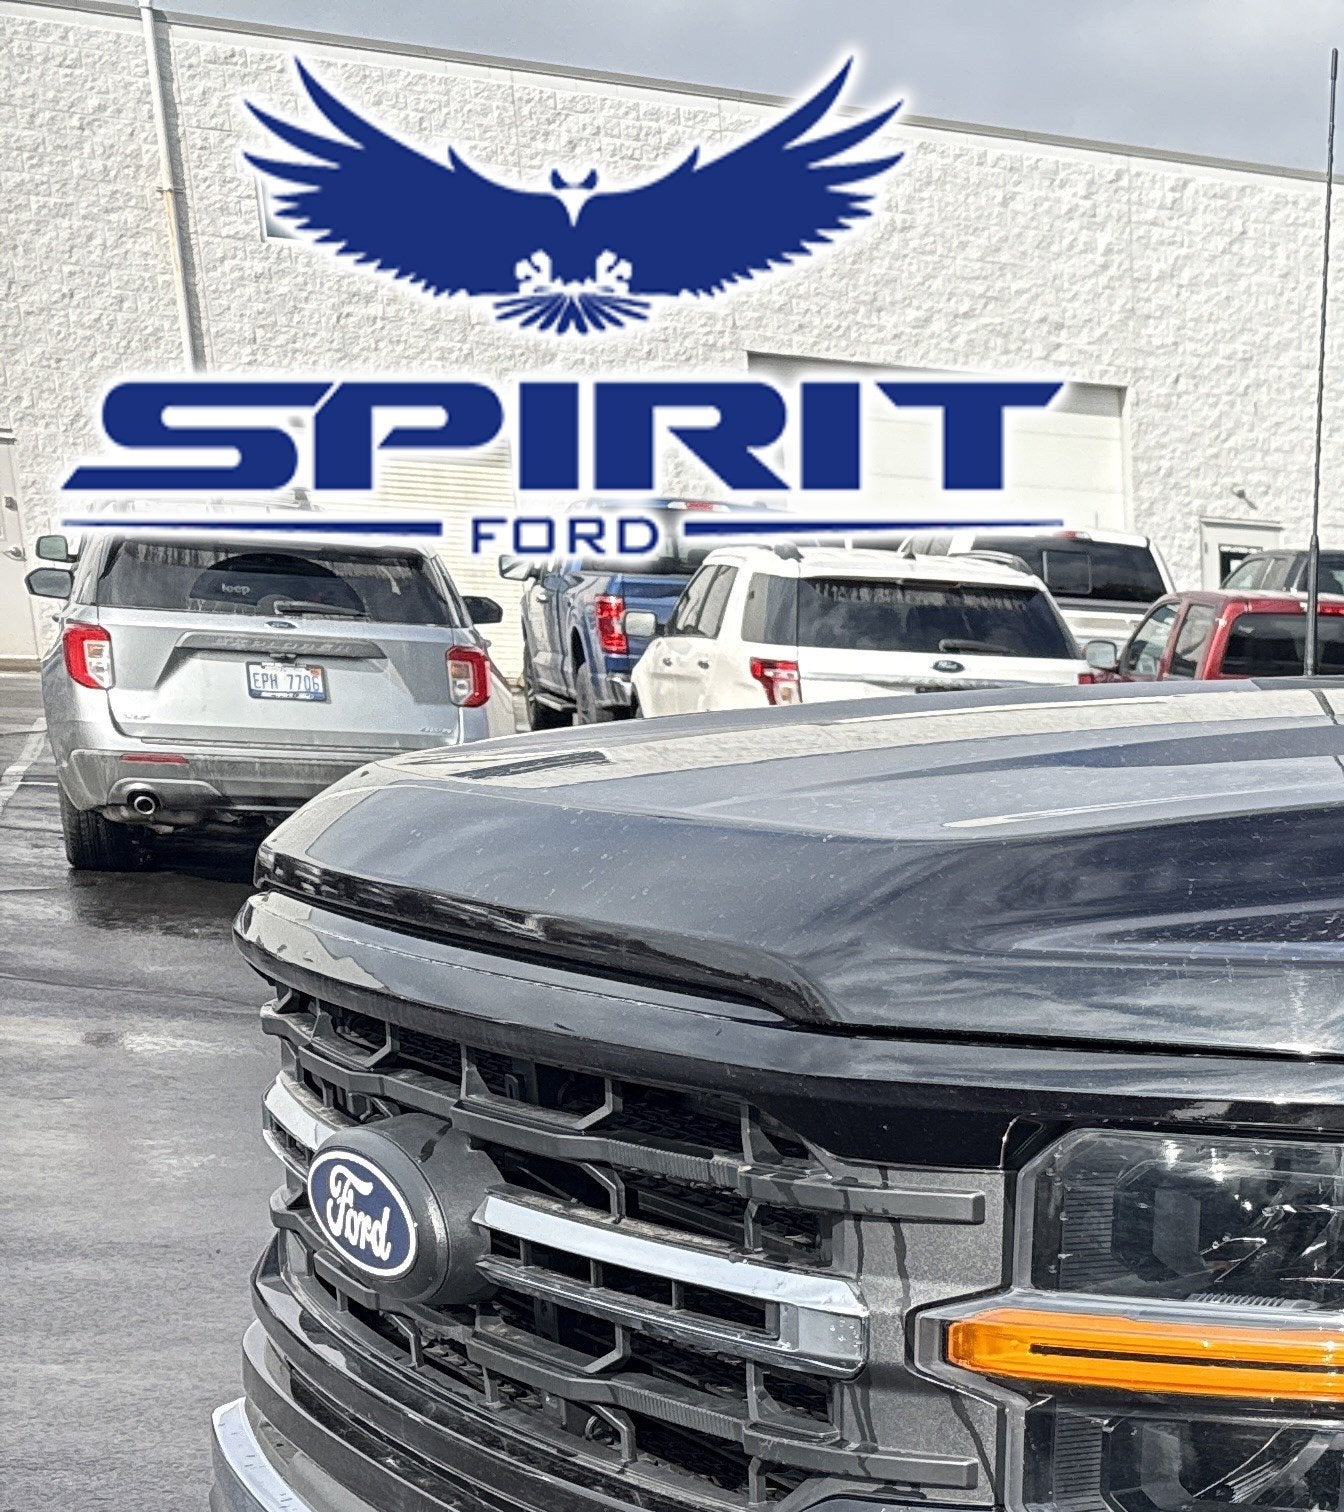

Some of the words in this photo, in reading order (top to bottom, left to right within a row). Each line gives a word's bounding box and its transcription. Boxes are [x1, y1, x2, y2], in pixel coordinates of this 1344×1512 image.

[252, 672, 279, 691] EPH
[286, 673, 320, 693] 7706
[326, 1164, 392, 1261] Ford
